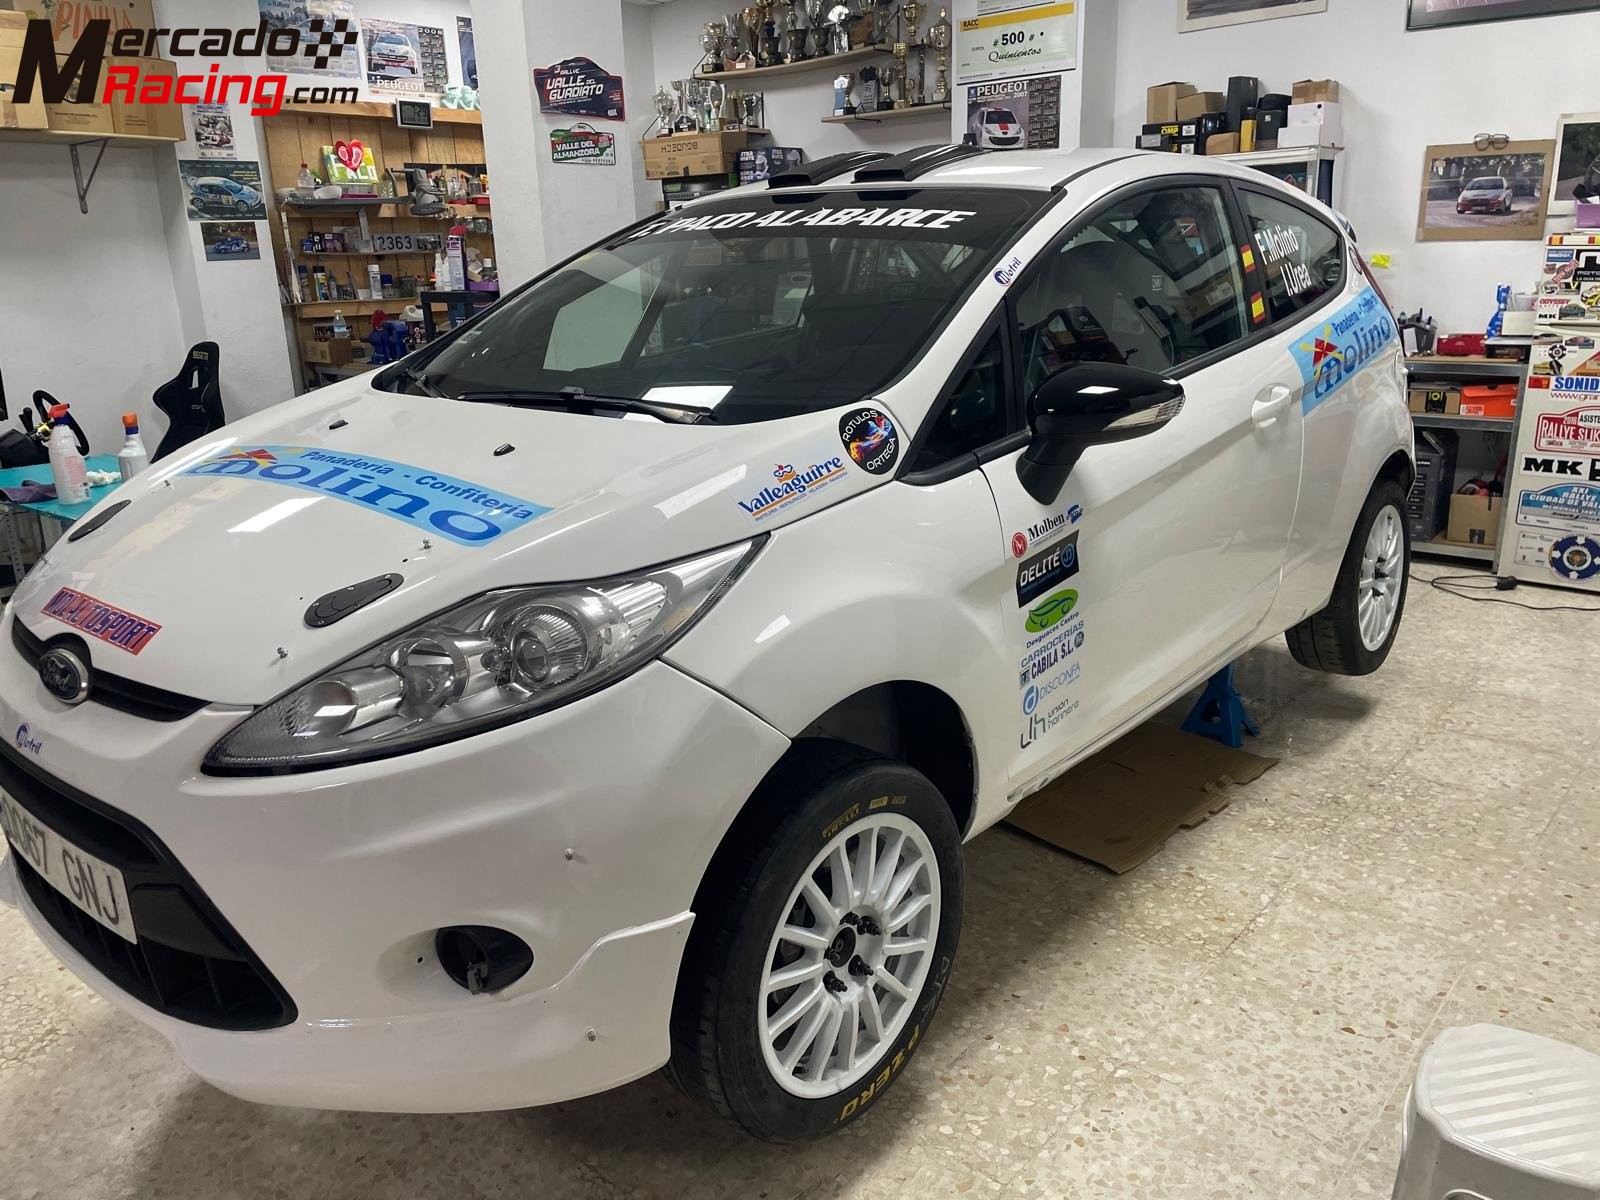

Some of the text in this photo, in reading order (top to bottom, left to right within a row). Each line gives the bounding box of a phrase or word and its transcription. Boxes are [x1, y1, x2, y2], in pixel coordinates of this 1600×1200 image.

[1001, 31, 1024, 46] 500
[988, 48, 1042, 63] Quinientos
[376, 79, 425, 92] PEUGEOT
[546, 75, 586, 90] VALLE
[977, 80, 1029, 96] PEUGEOT
[549, 83, 603, 100] GUADIATO
[1013, 91, 1028, 99] 2007
[553, 147, 600, 160] ALMANZORA
[556, 141, 596, 151] VALLE DEL
[654, 212, 757, 235] PACO
[738, 207, 976, 229] ALABARCE
[378, 235, 412, 250] 2363
[842, 410, 879, 442] ROTULOS
[1541, 420, 1576, 440] RALLYE
[867, 437, 896, 470] ORTEGA
[1523, 457, 1583, 476] MK
[738, 457, 843, 514] Valleaguirre
[1529, 494, 1564, 504] CIUDAD
[1562, 492, 1597, 501] RALLYE
[1027, 513, 1065, 541] Molben
[1026, 611, 1079, 649] Desguaces Castro
[1031, 649, 1059, 679] CABILA
[62, 848, 119, 925] GNJ
